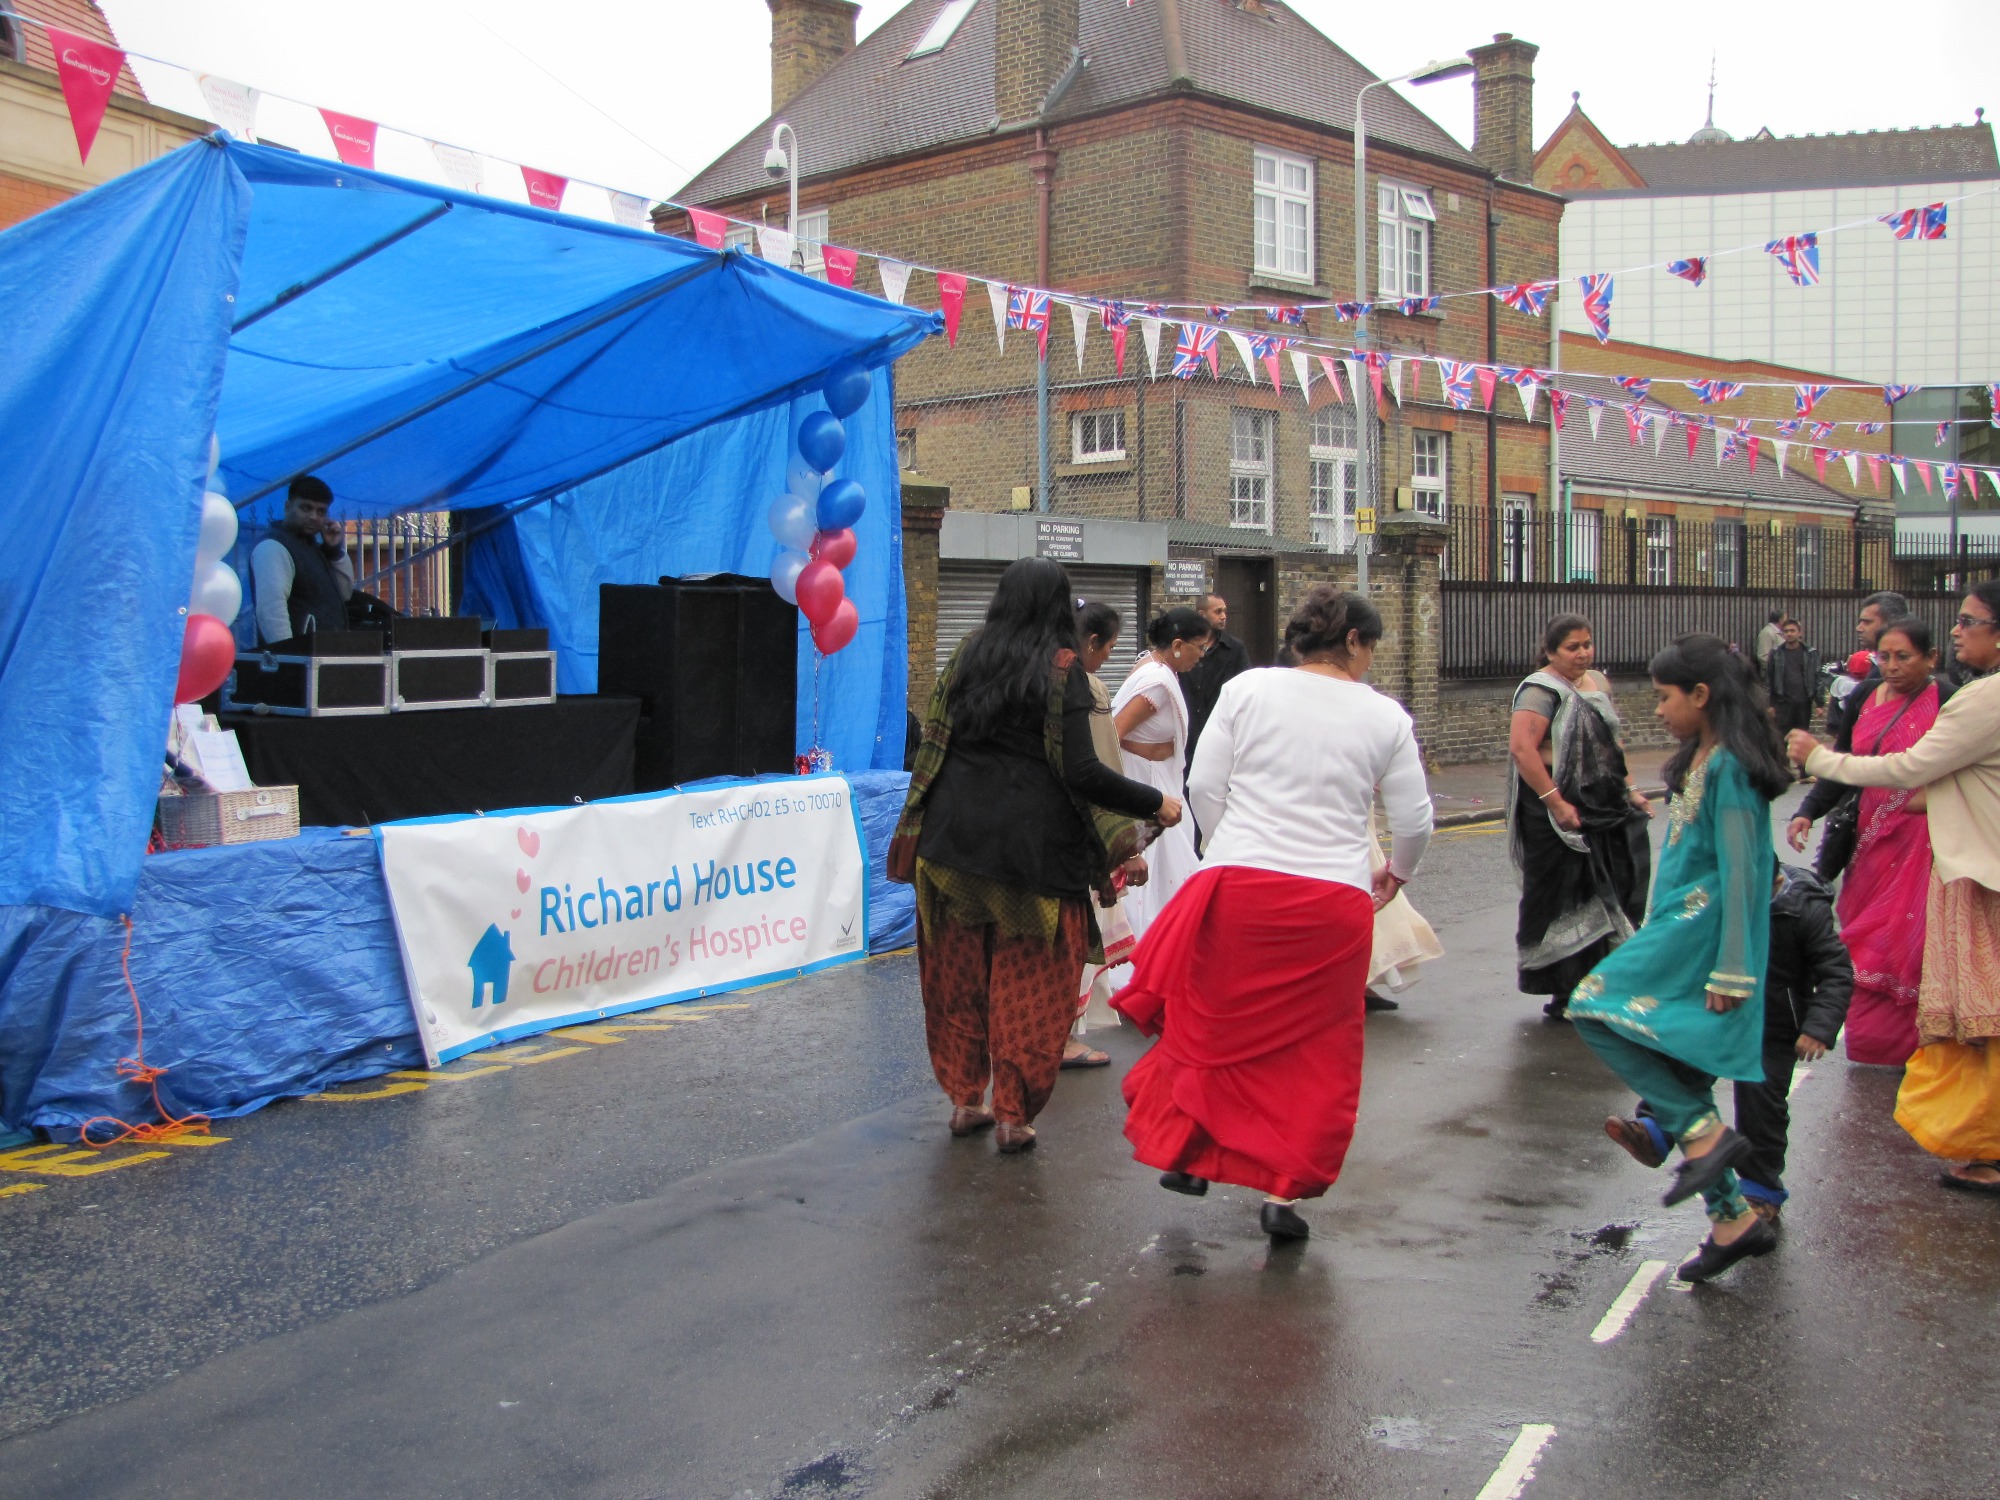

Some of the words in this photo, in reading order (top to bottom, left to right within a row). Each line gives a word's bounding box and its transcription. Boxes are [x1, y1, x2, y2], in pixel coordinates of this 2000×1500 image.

[89, 65, 111, 77] London
[1040, 523, 1051, 533] NO
[1052, 525, 1080, 535] PARKING
[1168, 562, 1177, 571] NO
[1179, 563, 1202, 572] PARKING
[689, 812, 717, 829] Text
[774, 798, 790, 816] £5
[793, 799, 806, 813] to
[807, 792, 842, 811] 70070
[540, 864, 682, 936] Richard
[692, 856, 797, 906] House
[533, 933, 681, 994] Children's
[689, 914, 807, 961] Hospice
